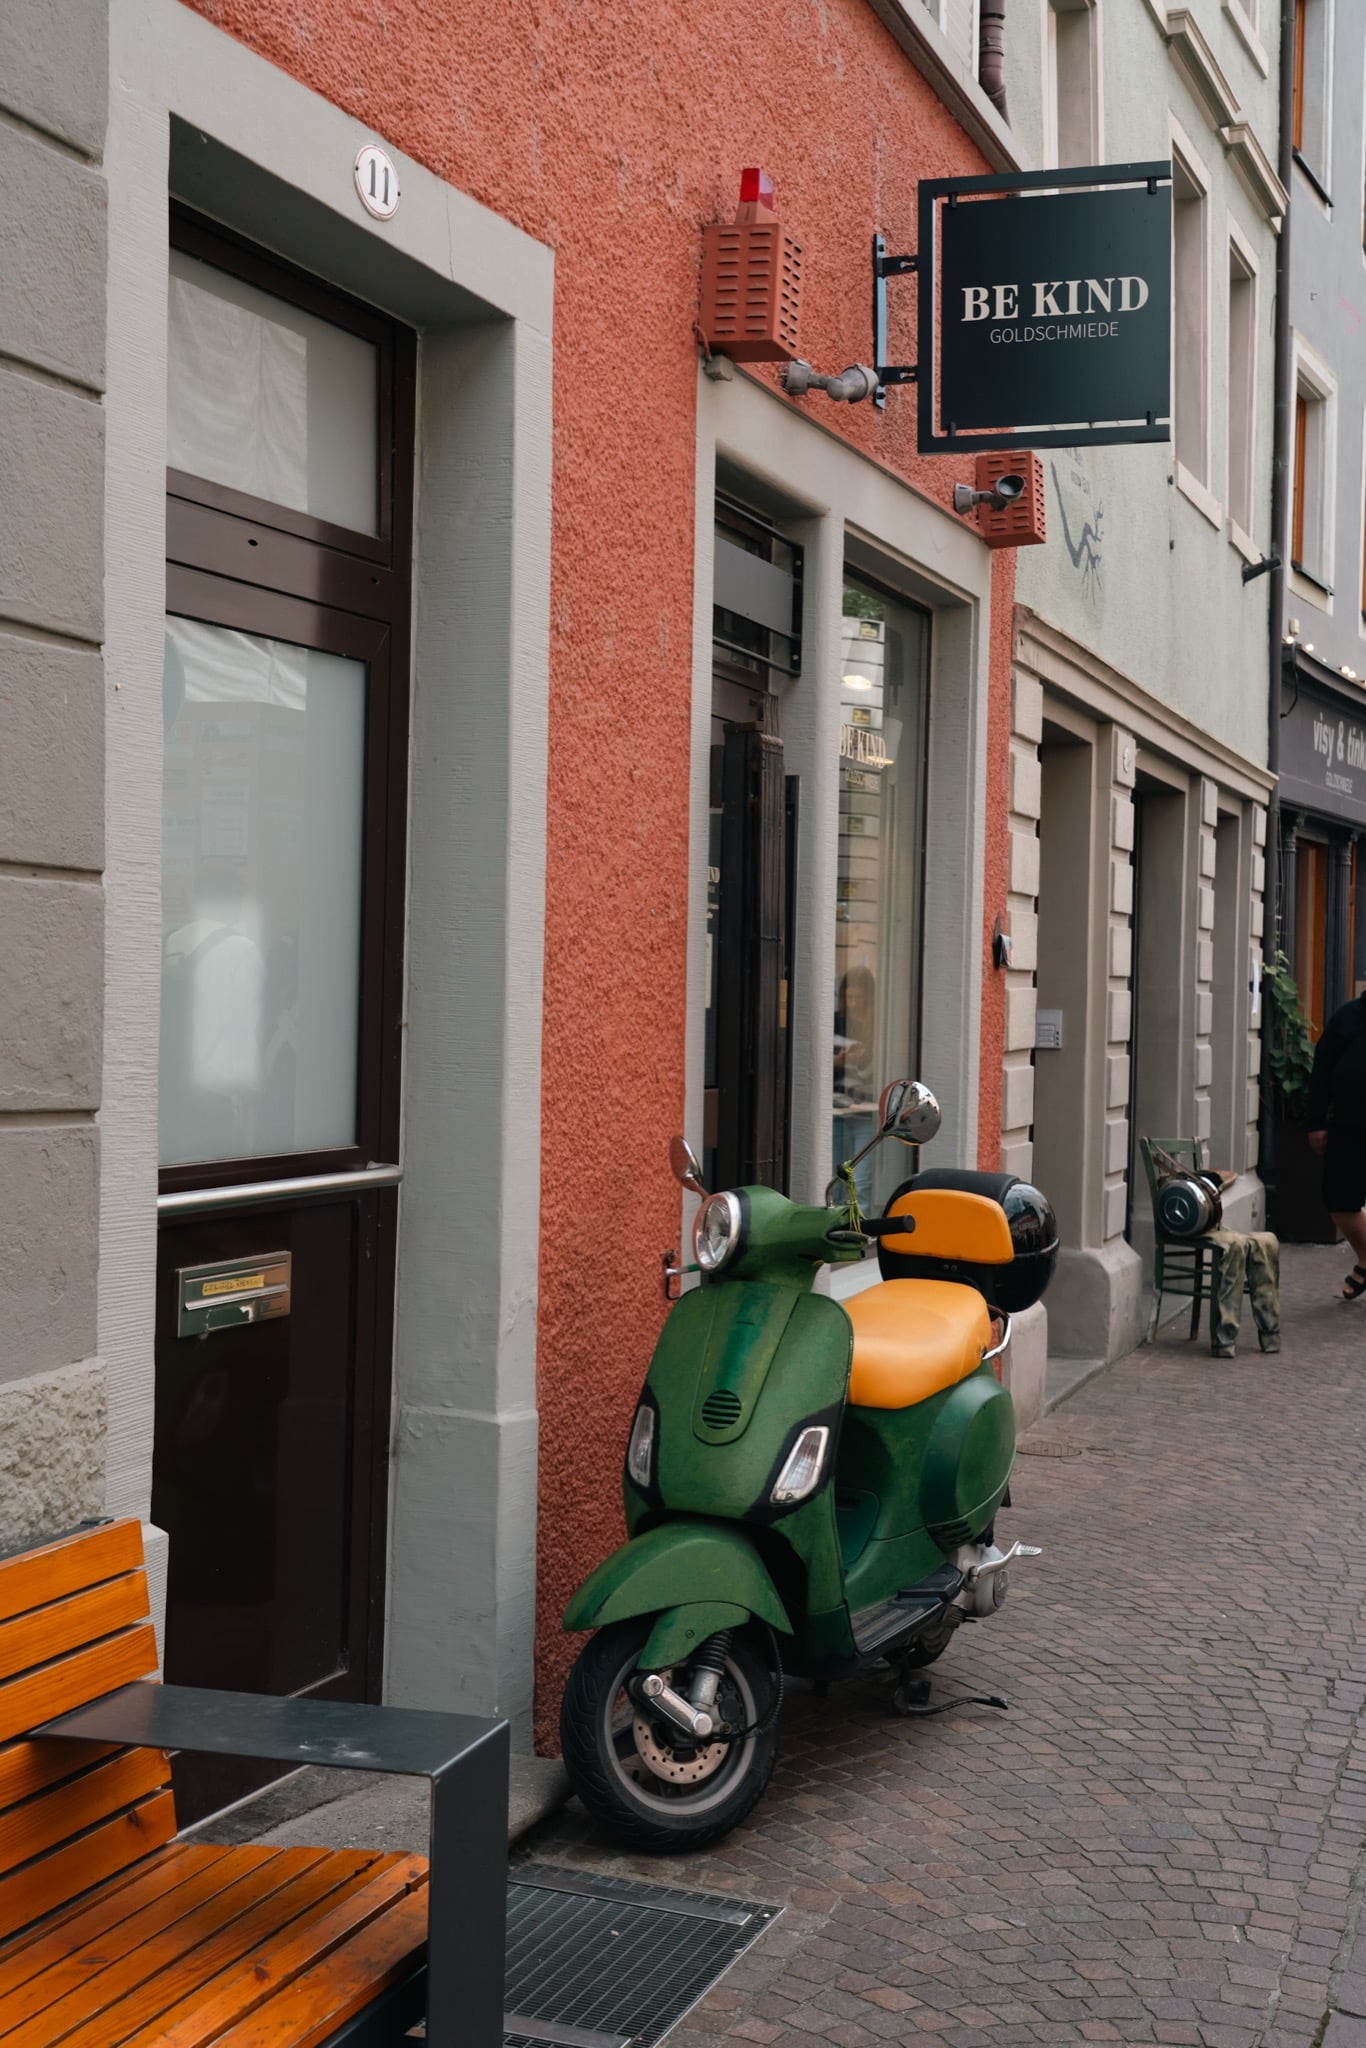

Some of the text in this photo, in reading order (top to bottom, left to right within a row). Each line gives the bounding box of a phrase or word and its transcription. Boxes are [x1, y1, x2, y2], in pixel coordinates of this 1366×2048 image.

[368, 158, 389, 206] 11
[960, 276, 1150, 322] BE KIND
[990, 321, 1120, 344] GOLDSCHMIEDE
[840, 723, 887, 769] BE KIND
[1313, 711, 1366, 773] visy & tink
